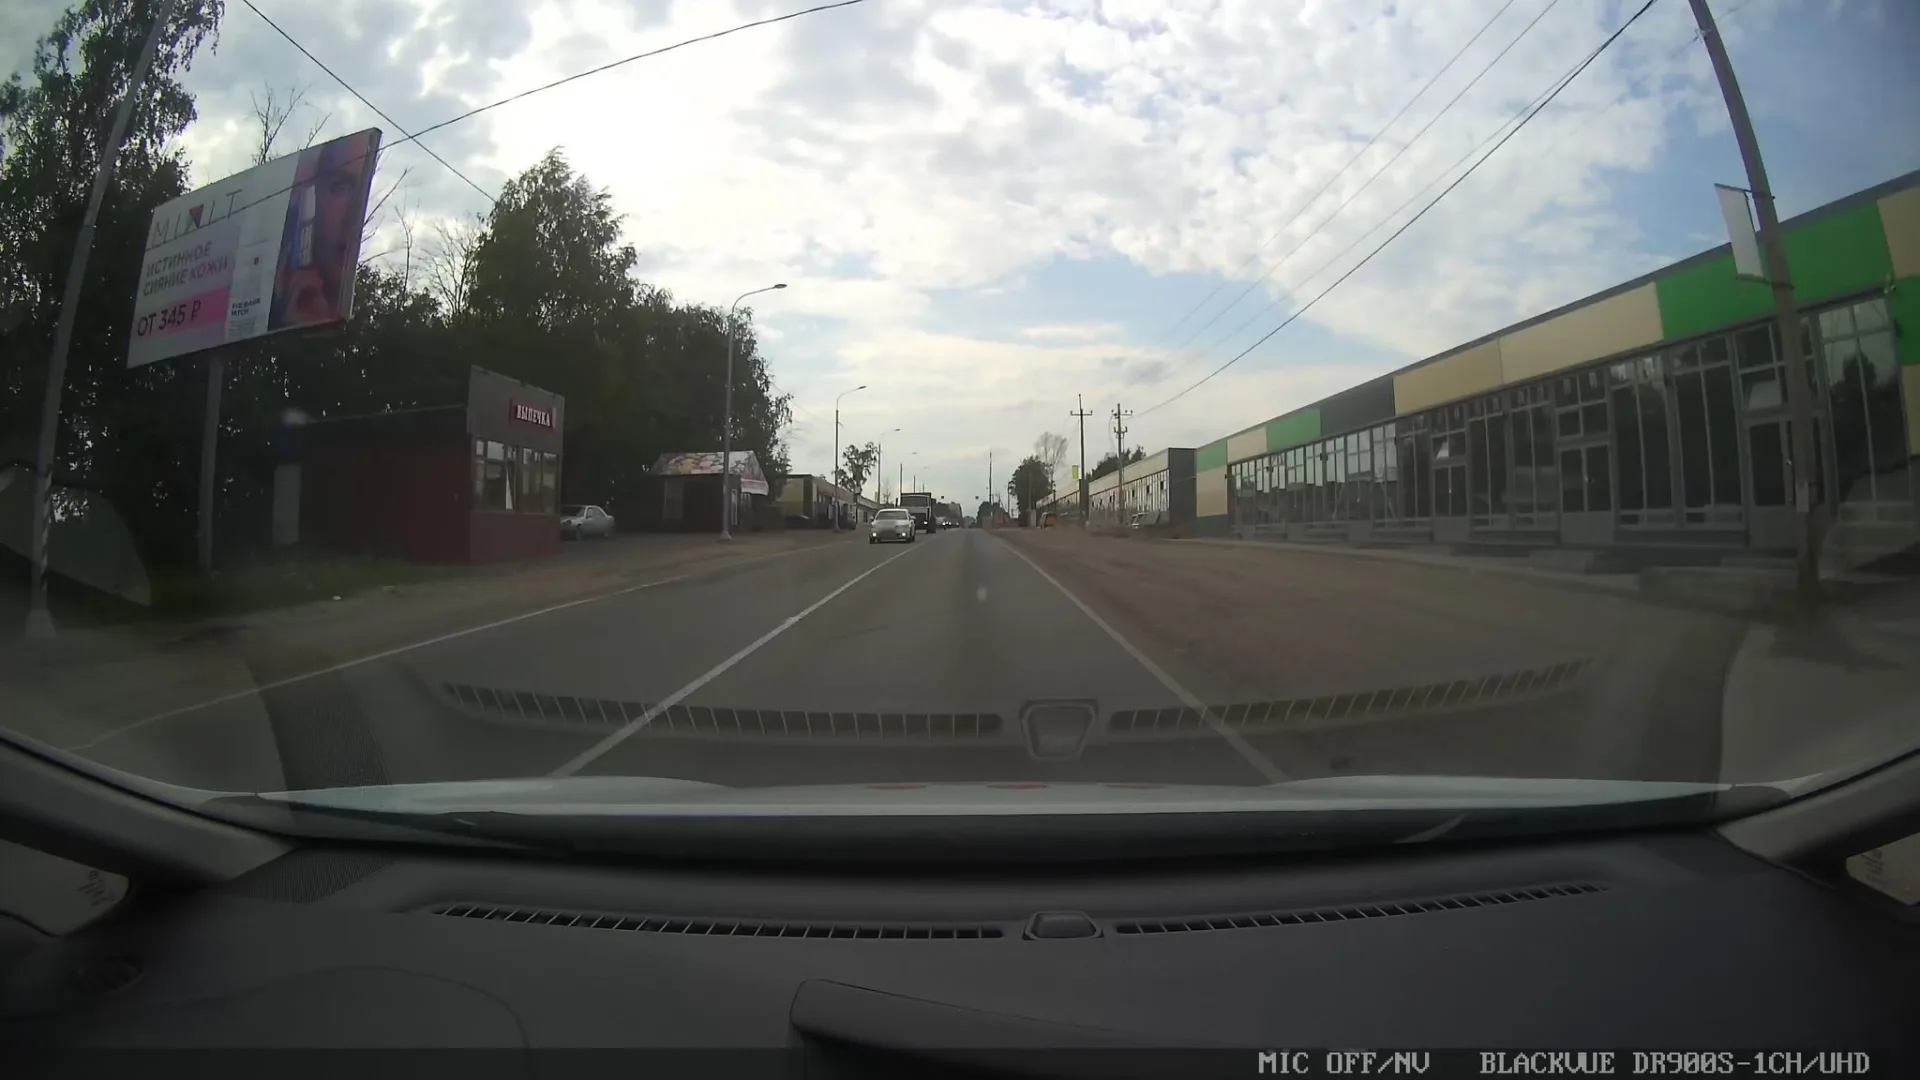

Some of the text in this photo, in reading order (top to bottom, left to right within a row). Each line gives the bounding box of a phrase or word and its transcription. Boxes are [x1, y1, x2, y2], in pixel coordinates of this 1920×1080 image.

[147, 241, 212, 277] ИСТИННОЕ
[143, 256, 228, 297] СИЯНИЕ КОЖИ
[137, 312, 157, 336] ОТ
[158, 303, 187, 331] 345
[516, 404, 551, 427] ВЫПЕЧКА
